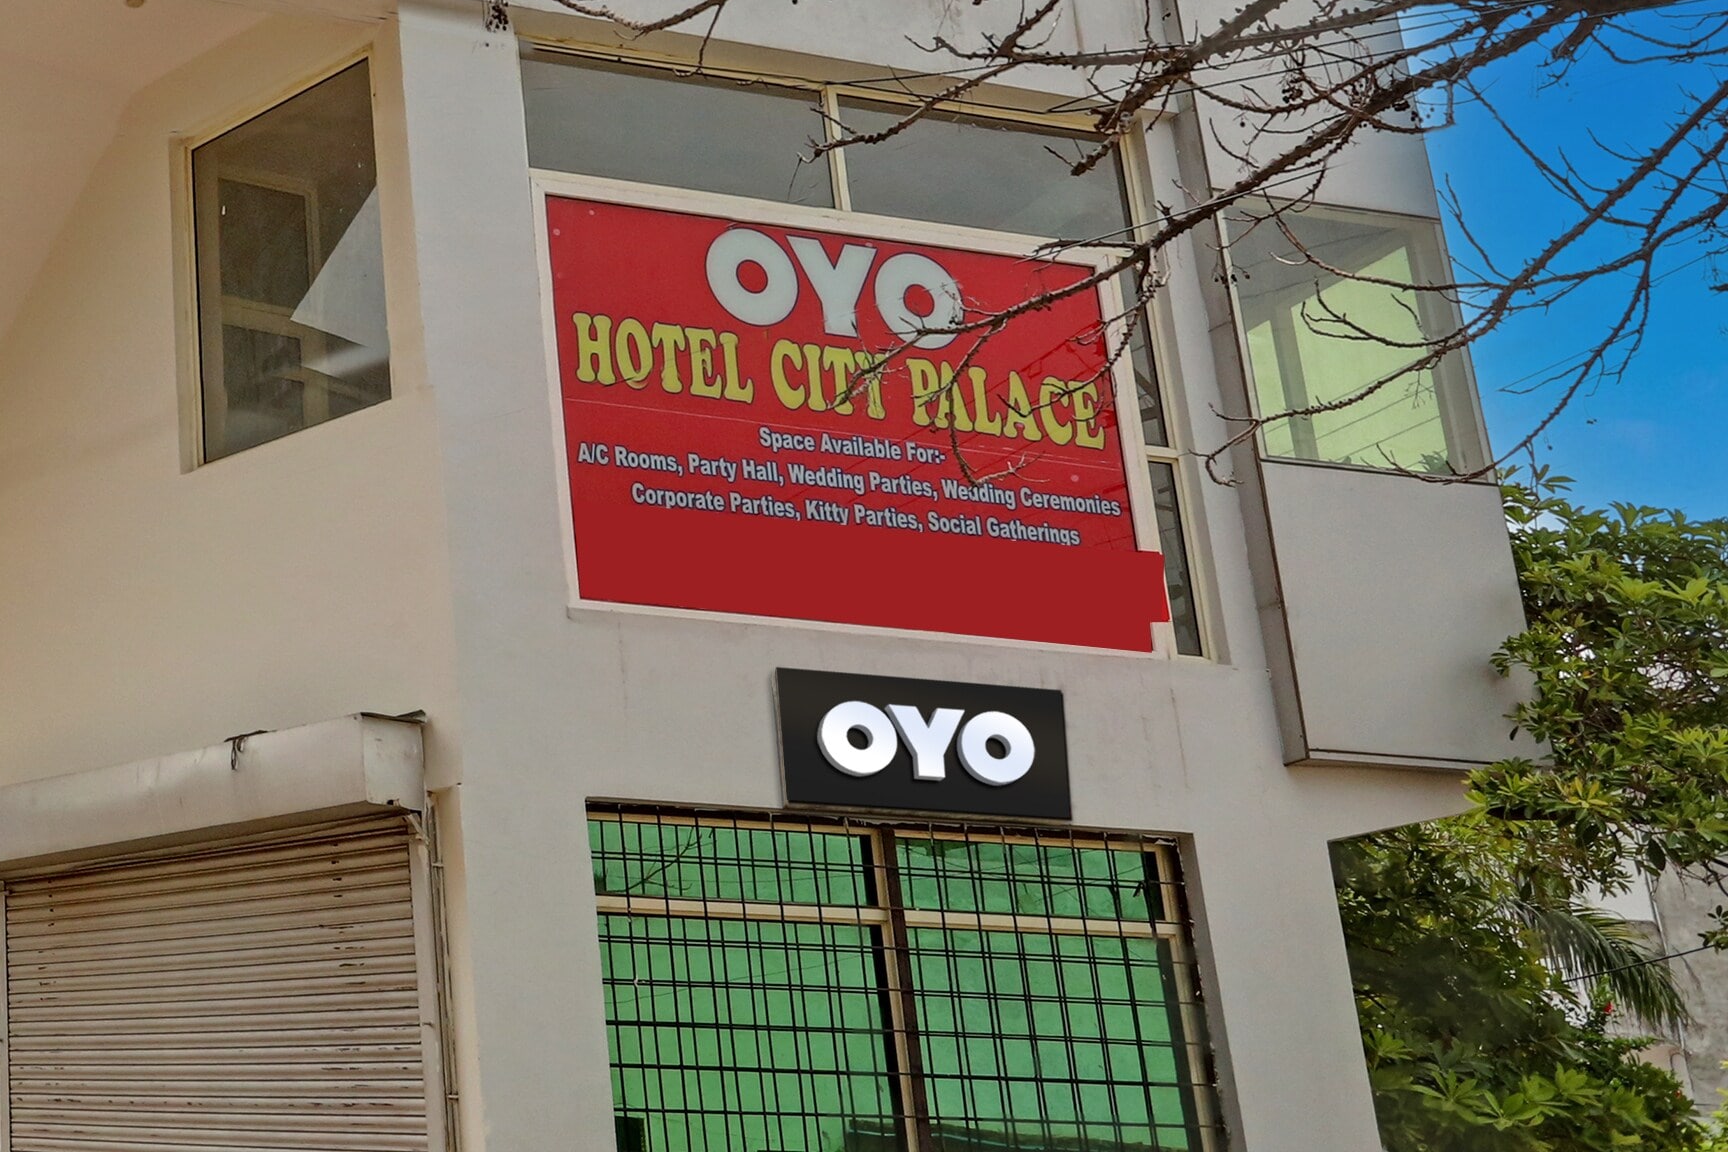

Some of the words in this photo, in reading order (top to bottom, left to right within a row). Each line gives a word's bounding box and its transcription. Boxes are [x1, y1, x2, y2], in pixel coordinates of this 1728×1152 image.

[705, 227, 964, 350] OYO
[572, 311, 754, 404] HOTEL
[770, 339, 886, 420] CITY
[906, 358, 1105, 450] PALACE
[577, 442, 609, 466] A/C
[614, 445, 683, 477] Rooms,
[688, 453, 737, 483] Party
[742, 459, 785, 487] Hall,
[787, 463, 865, 495] Wedding
[869, 471, 939, 502] Parties,
[941, 479, 1017, 510] Wedding
[1020, 488, 1122, 517] Ceremonies
[758, 427, 816, 453] Space
[820, 433, 902, 460] Available
[906, 441, 946, 466] For:-
[631, 482, 725, 512] Corporate
[729, 492, 802, 522] Parties,
[805, 499, 849, 526] Kitty
[853, 504, 923, 533] Parties,
[928, 511, 983, 536] Social
[986, 519, 1081, 546] Gatherings
[817, 700, 1036, 786] OYO
